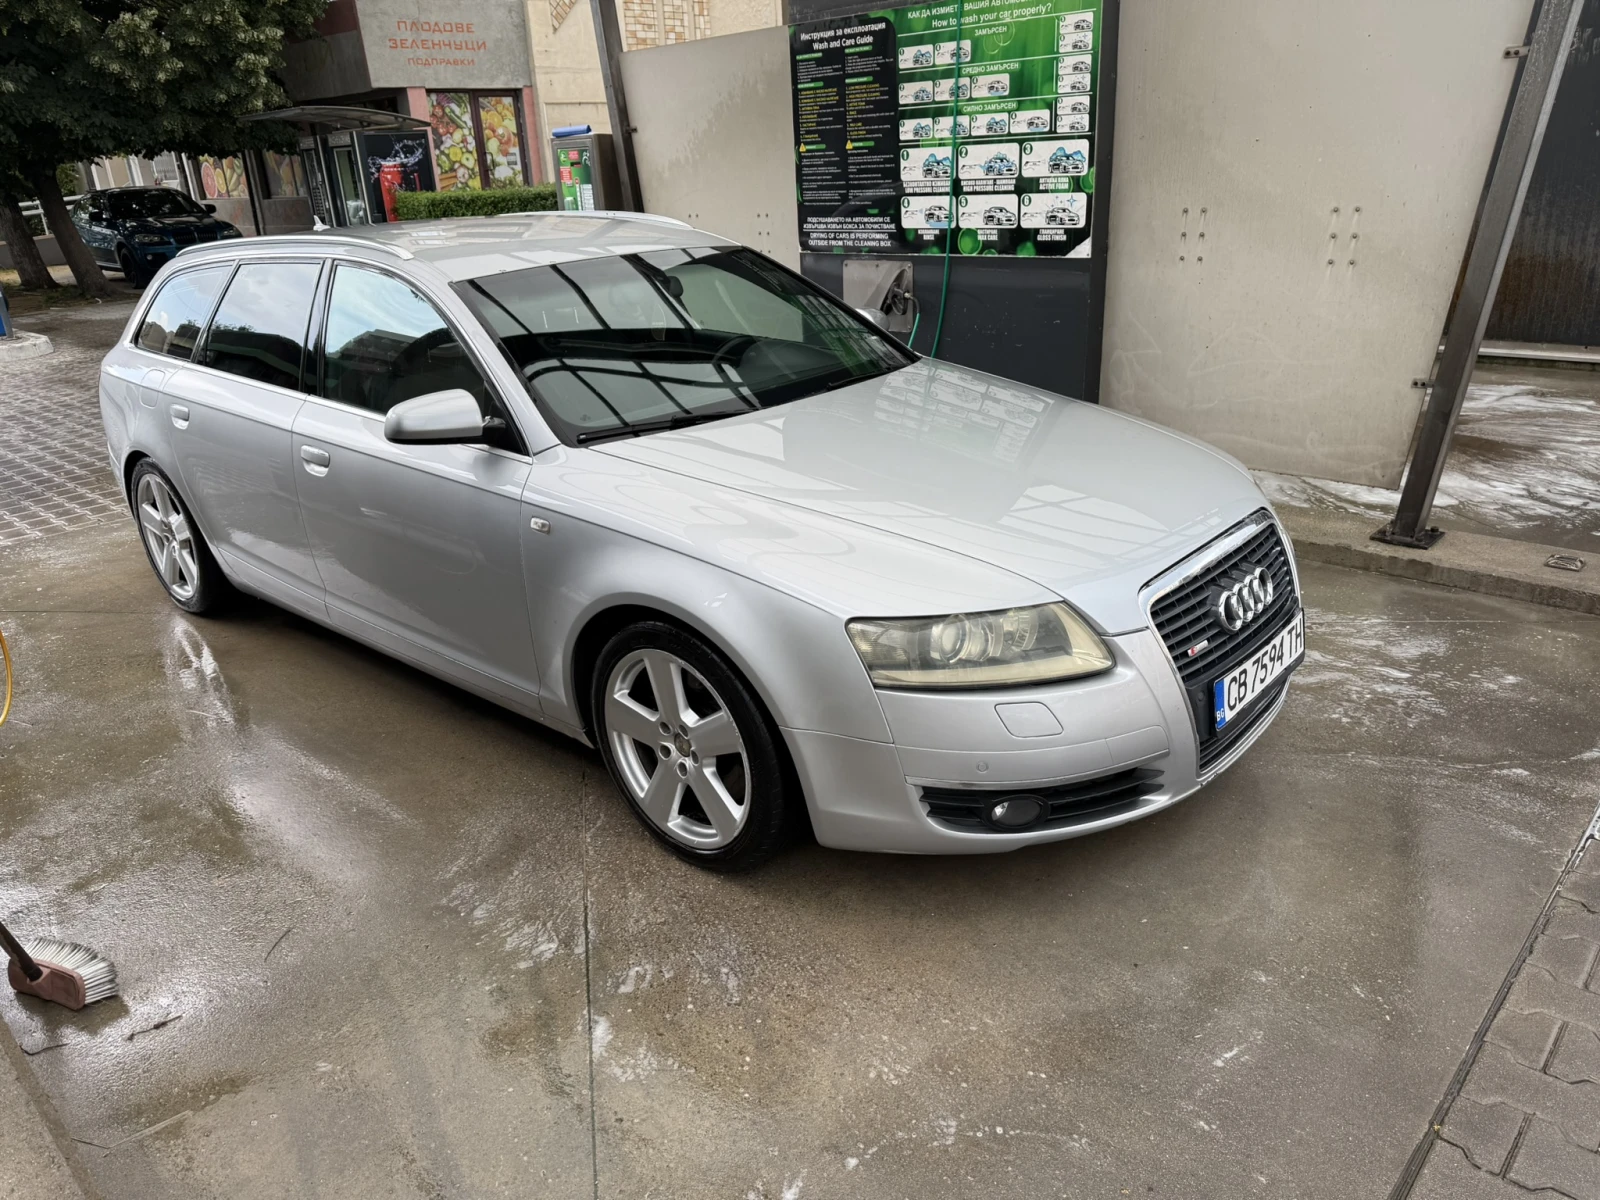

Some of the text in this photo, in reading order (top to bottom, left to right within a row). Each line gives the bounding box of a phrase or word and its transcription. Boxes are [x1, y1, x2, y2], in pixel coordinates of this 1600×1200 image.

[921, 10, 930, 18] ДА
[932, 5, 962, 15] ИЗМИЕТ
[964, 0, 990, 11] ВАШИЯ
[932, 19, 948, 28] How
[950, 17, 957, 25] to
[980, 12, 998, 23] your
[999, 10, 1011, 18] car
[1012, 4, 1052, 18] properly?
[396, 20, 475, 34] ПЛОДОВЕ
[800, 29, 835, 41] Инструкция
[844, 22, 886, 34] експлоатация
[974, 26, 1007, 36] ЗАМЪРСЕН
[388, 38, 487, 51] ЗЕЛЕНЧУЦИ
[813, 35, 873, 50] Wash and Care Guide
[407, 58, 475, 67] ПОДПРАВКИ
[962, 63, 1019, 75] СРЕДНО ЗАМЪРСЕН
[963, 104, 982, 112] СИЛНО
[1227, 618, 1302, 711] CB 7594 TH
[1216, 708, 1224, 722] BG
